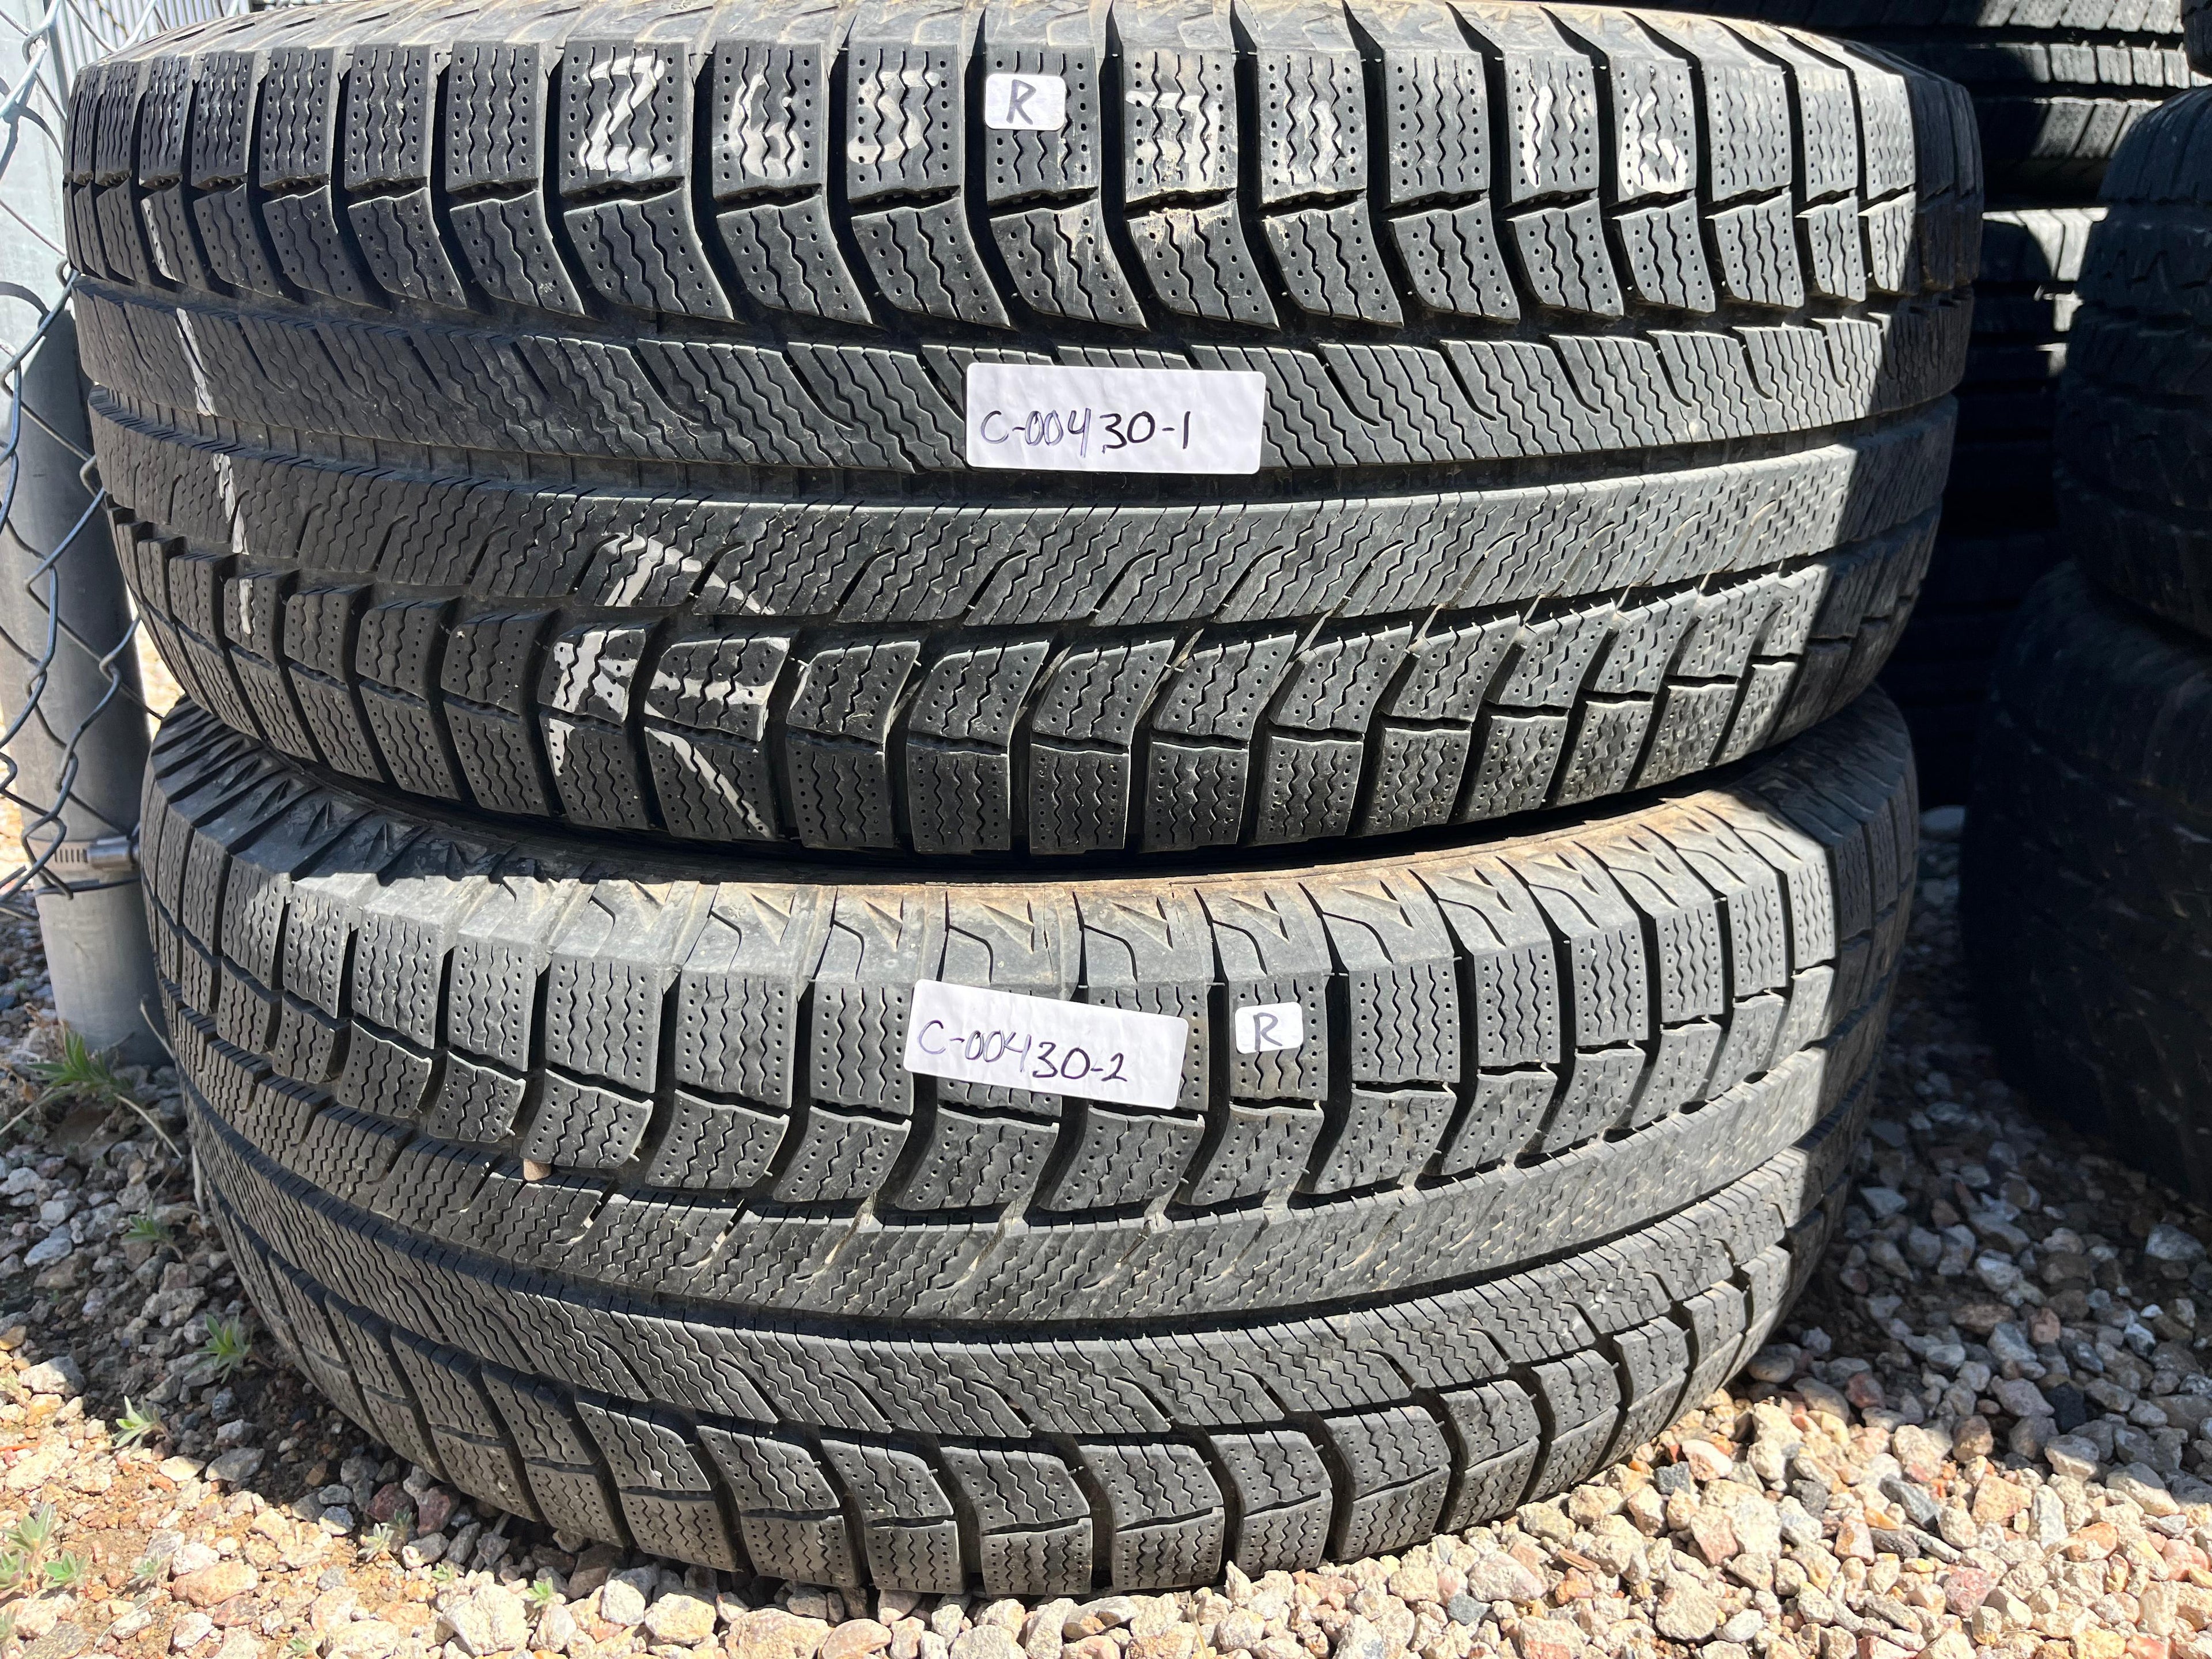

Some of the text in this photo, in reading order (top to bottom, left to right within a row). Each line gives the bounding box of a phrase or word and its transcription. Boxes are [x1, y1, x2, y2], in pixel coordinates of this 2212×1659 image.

[1006, 79, 1036, 126] R
[979, 408, 1191, 457] C-00430-1
[918, 1019, 1128, 1082] C-00430-2
[1253, 1012, 1283, 1051] R
